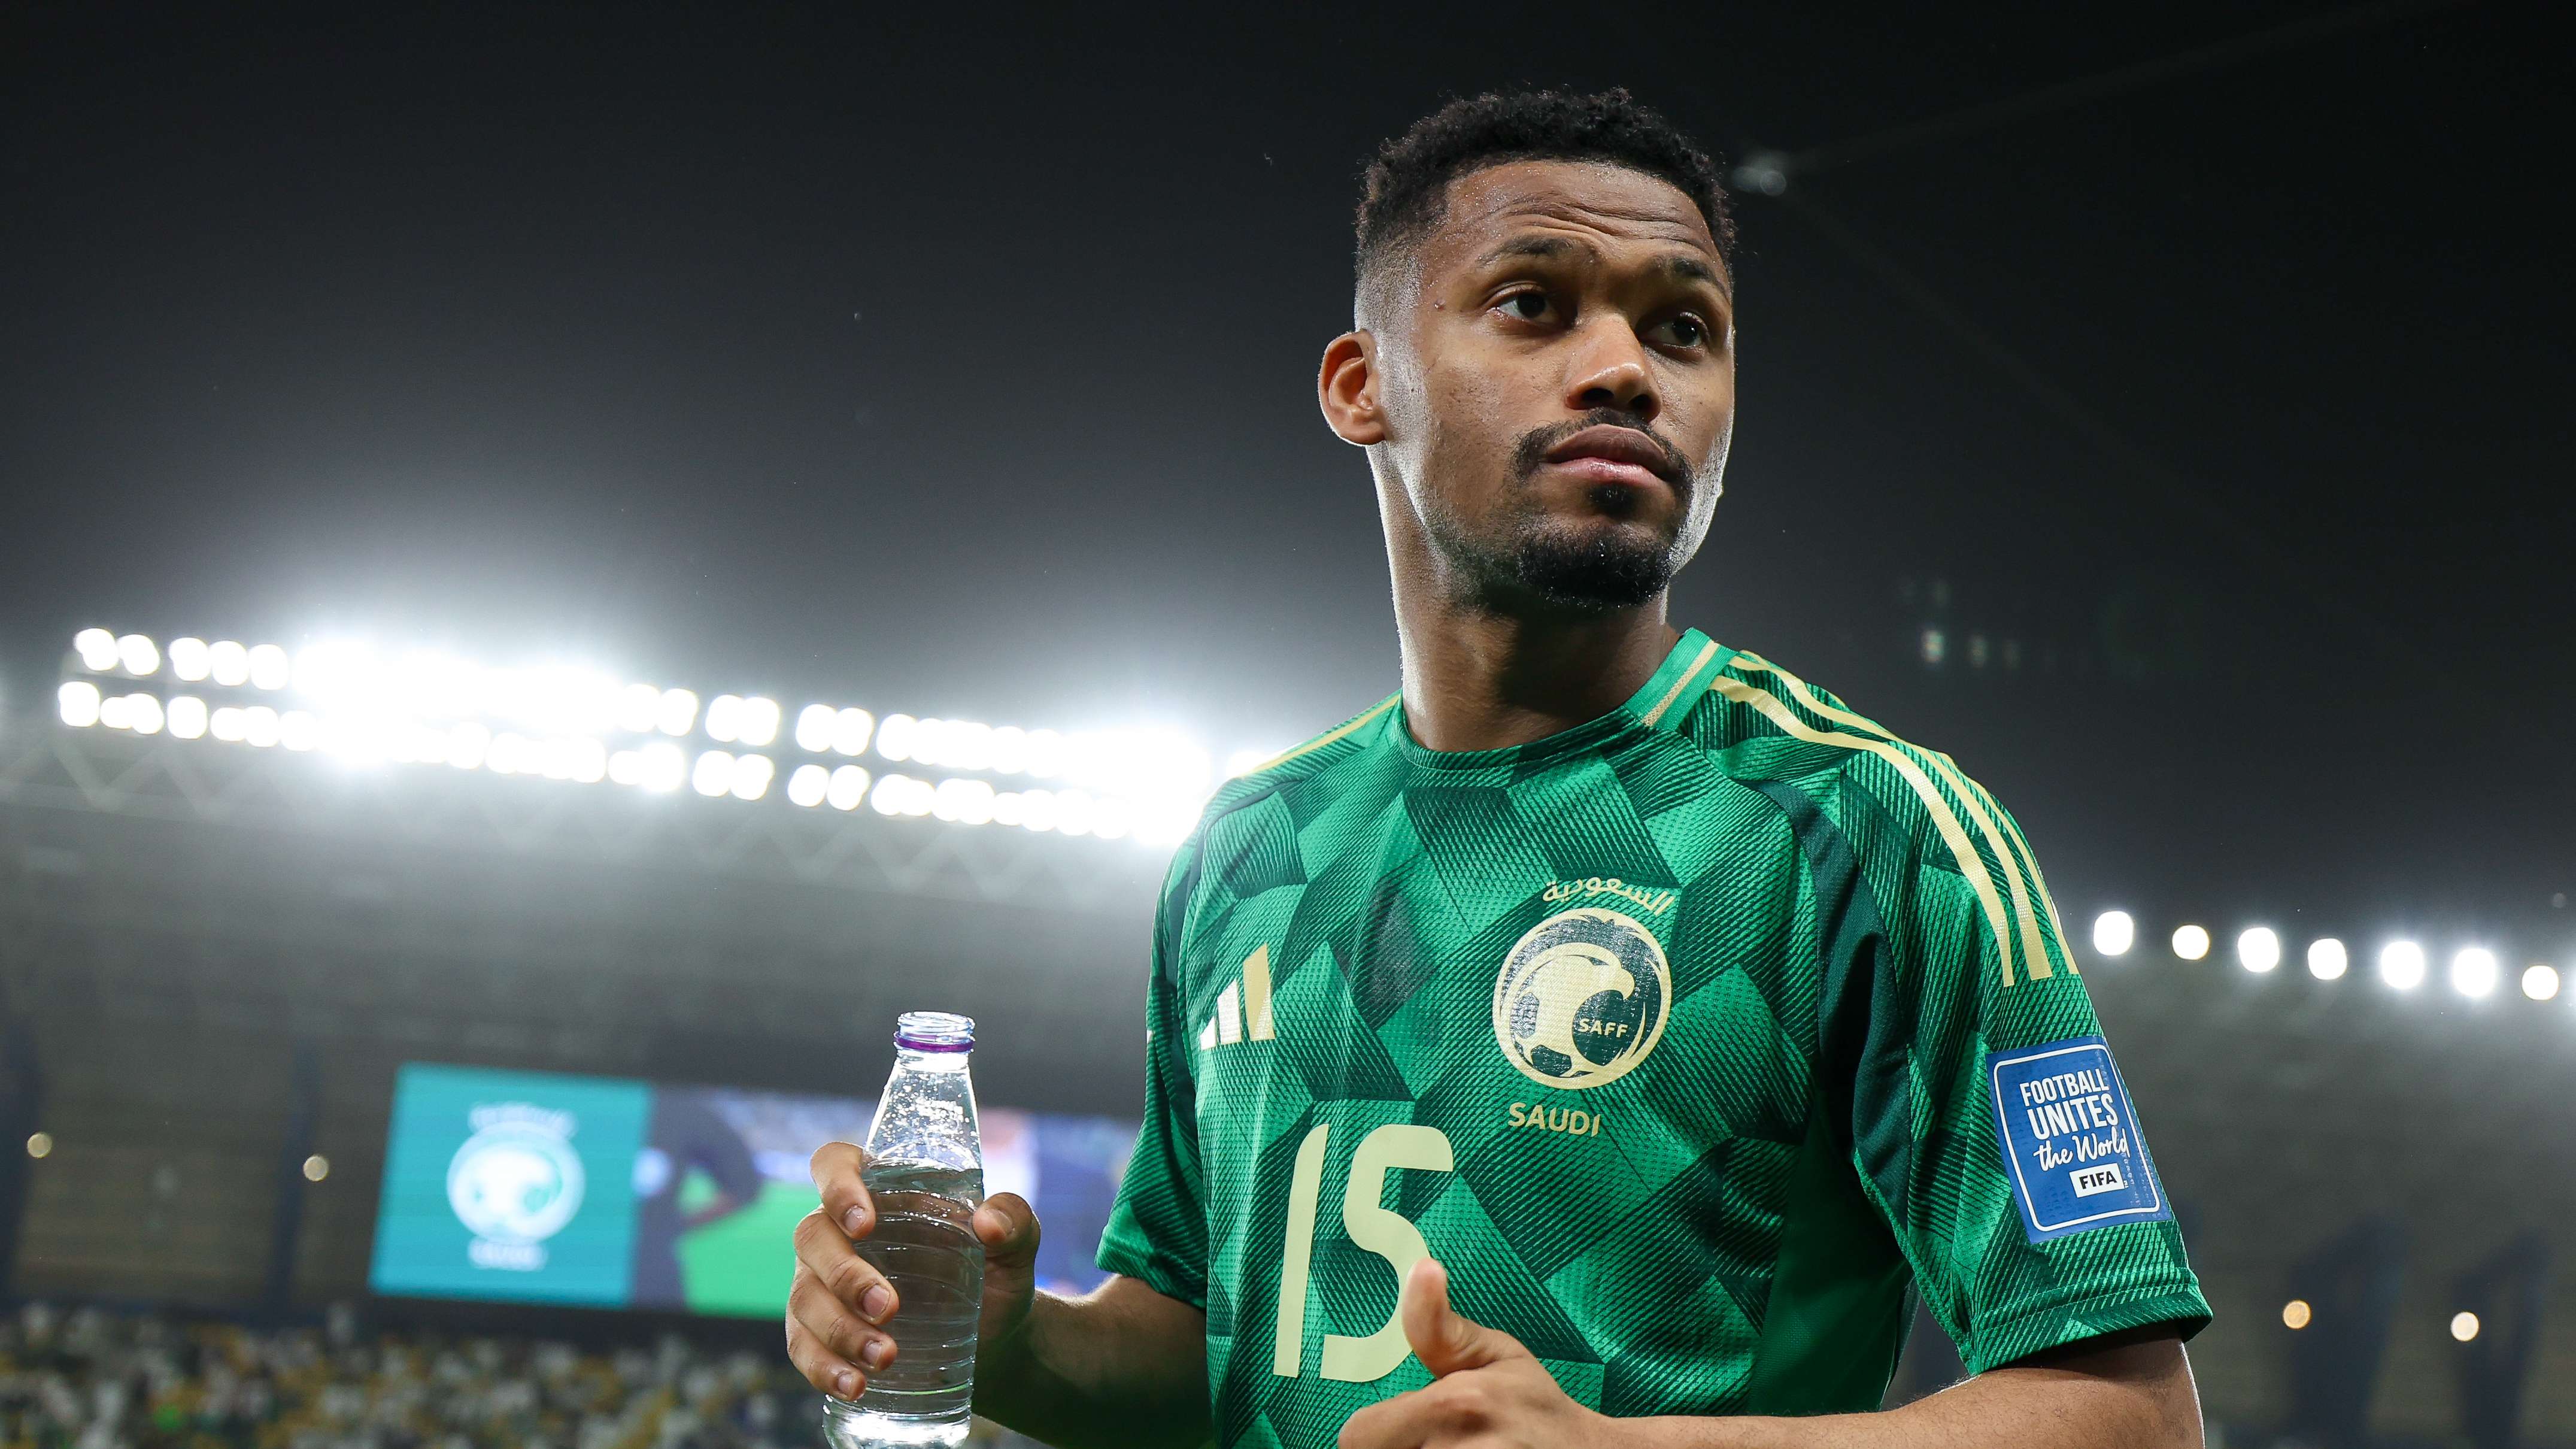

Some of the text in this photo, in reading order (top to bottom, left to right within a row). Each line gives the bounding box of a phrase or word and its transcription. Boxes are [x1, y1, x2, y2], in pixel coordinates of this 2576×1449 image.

[1543, 877, 1675, 917] السعودية
[1579, 1018, 1628, 1039] SAFF
[2019, 1068, 2110, 1107] FOOTBALL
[1507, 1102, 1601, 1137] SAUDI
[2026, 1093, 2119, 1140] UNITES
[2033, 1126, 2131, 1171] the World
[2079, 1170, 2117, 1190] FIFA
[1273, 1123, 1454, 1383] 15
